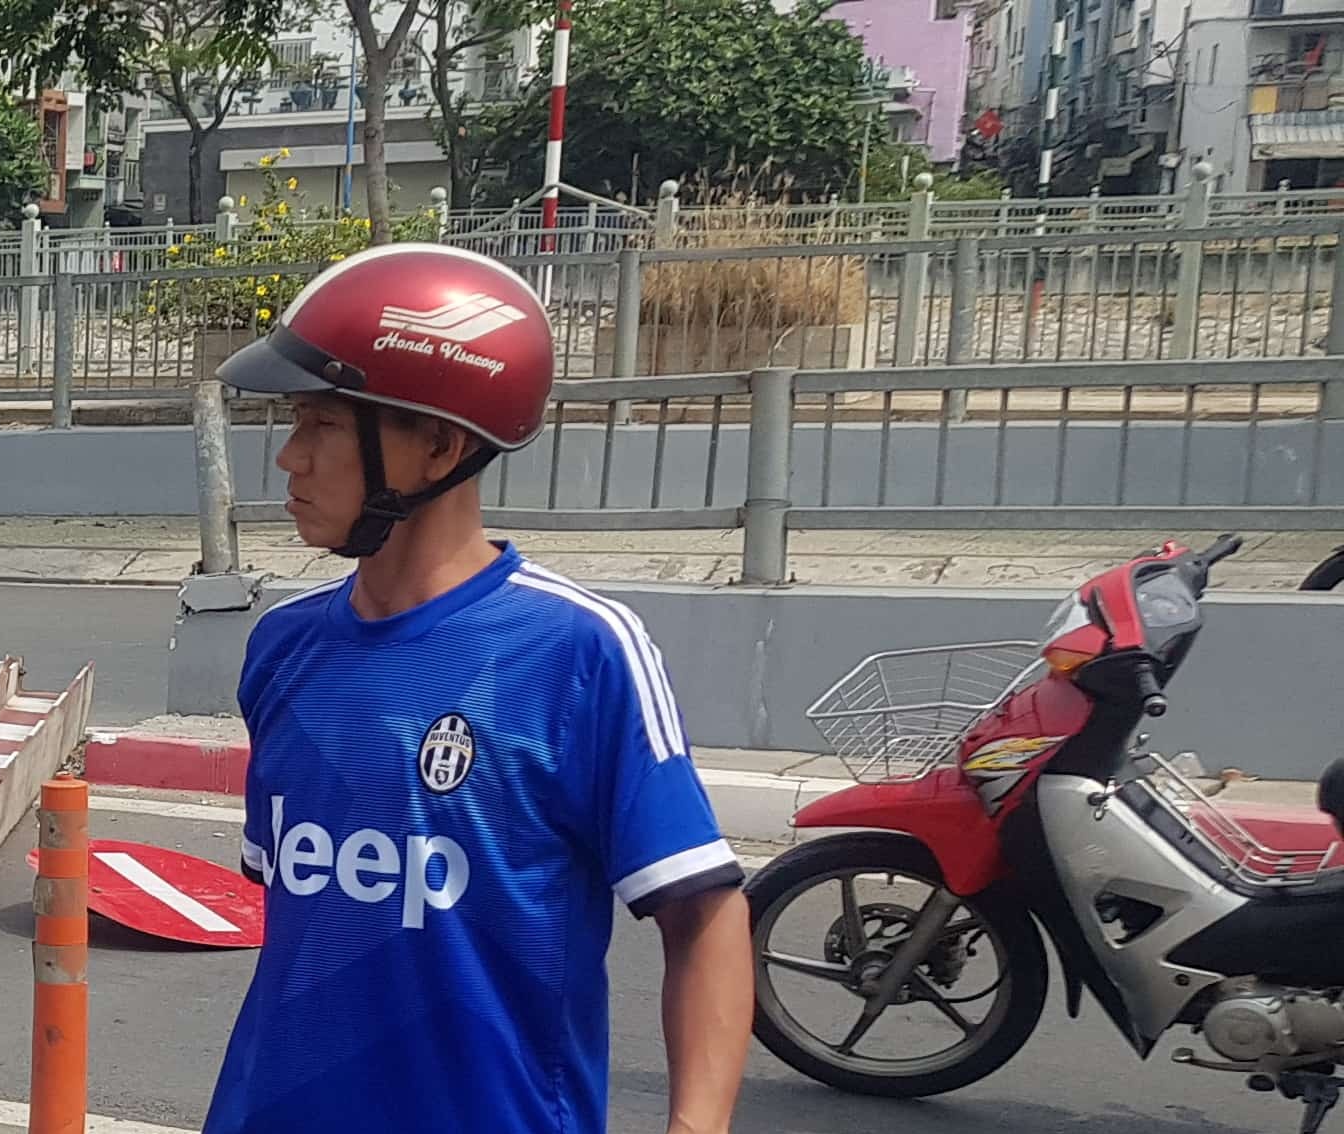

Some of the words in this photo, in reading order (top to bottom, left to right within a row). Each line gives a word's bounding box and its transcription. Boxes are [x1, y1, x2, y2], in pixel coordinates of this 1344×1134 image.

[373, 331, 434, 355] Honda
[430, 731, 470, 748] JUVENTUS
[261, 795, 470, 929] Jeep
